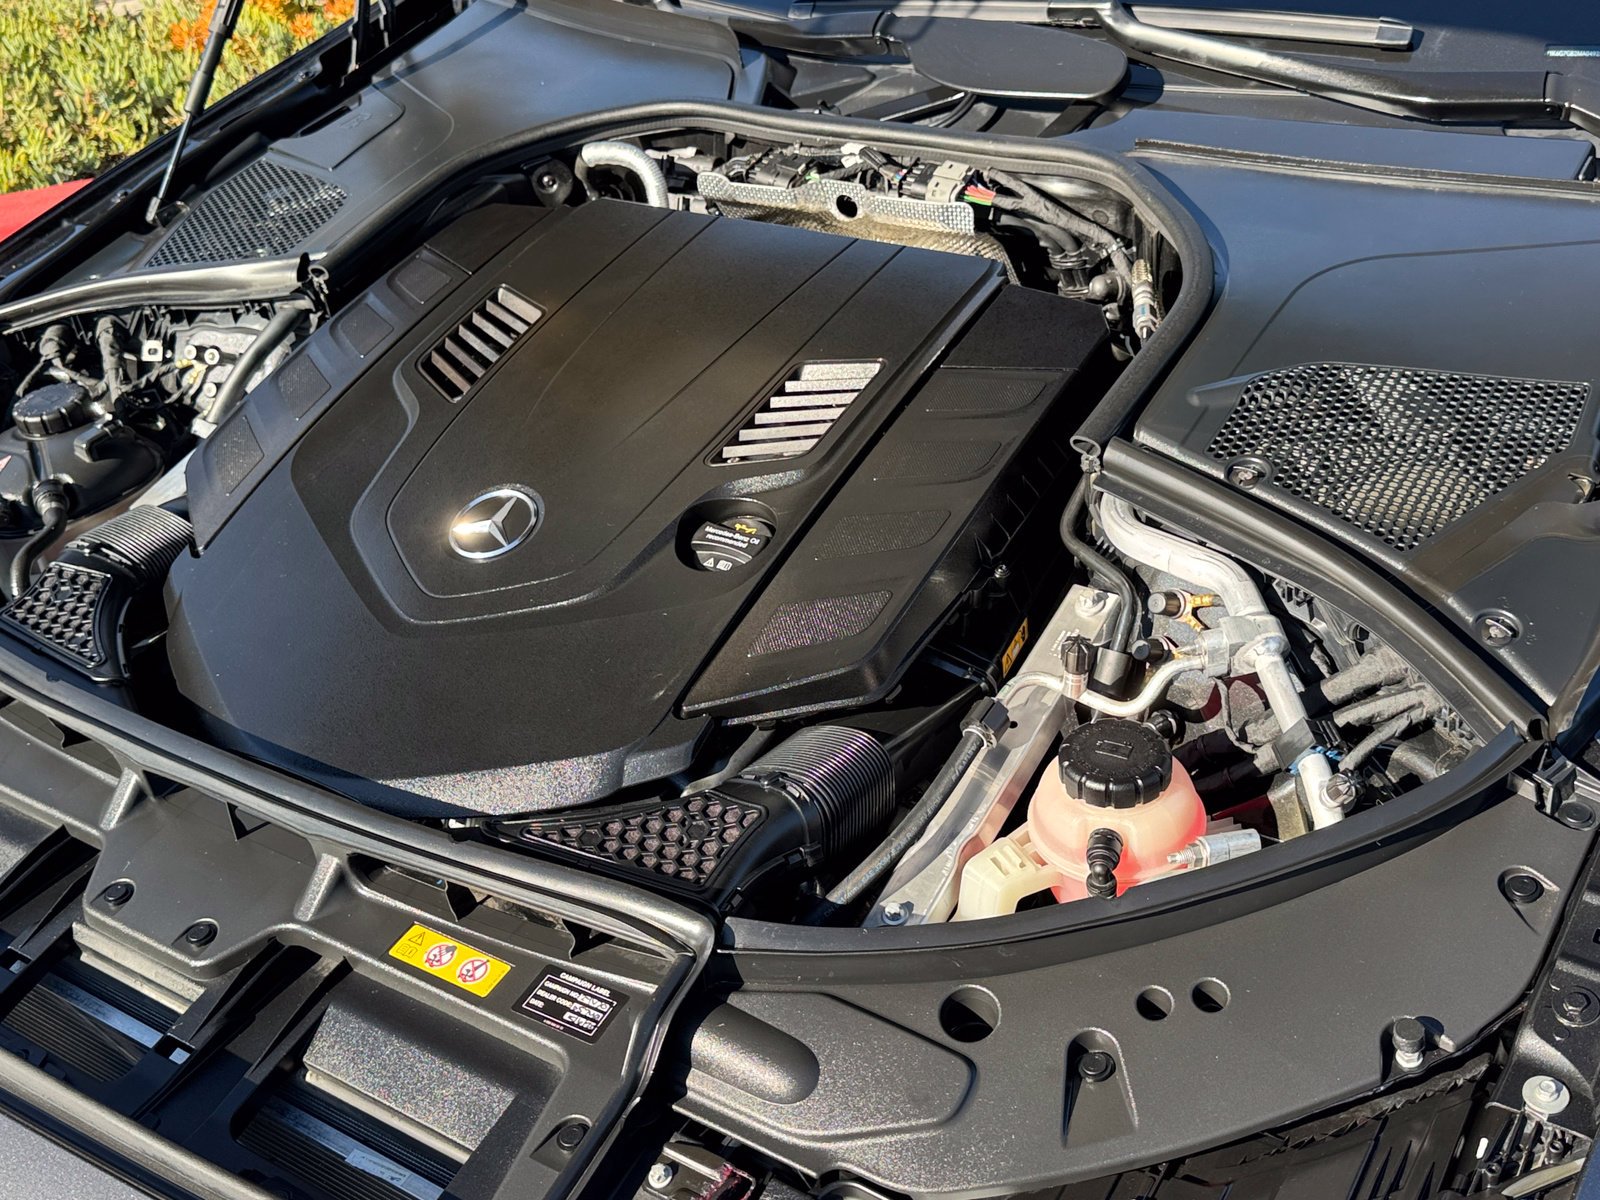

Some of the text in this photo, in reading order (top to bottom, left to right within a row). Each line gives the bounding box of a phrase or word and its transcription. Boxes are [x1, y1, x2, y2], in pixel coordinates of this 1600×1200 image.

[704, 525, 760, 545] Mercedes-Benz Oil
[705, 533, 749, 549] recommended
[543, 980, 571, 996] CAMPAIGN
[559, 972, 611, 998] CAMPAIGN LABEL
[536, 988, 558, 1002] DEALER
